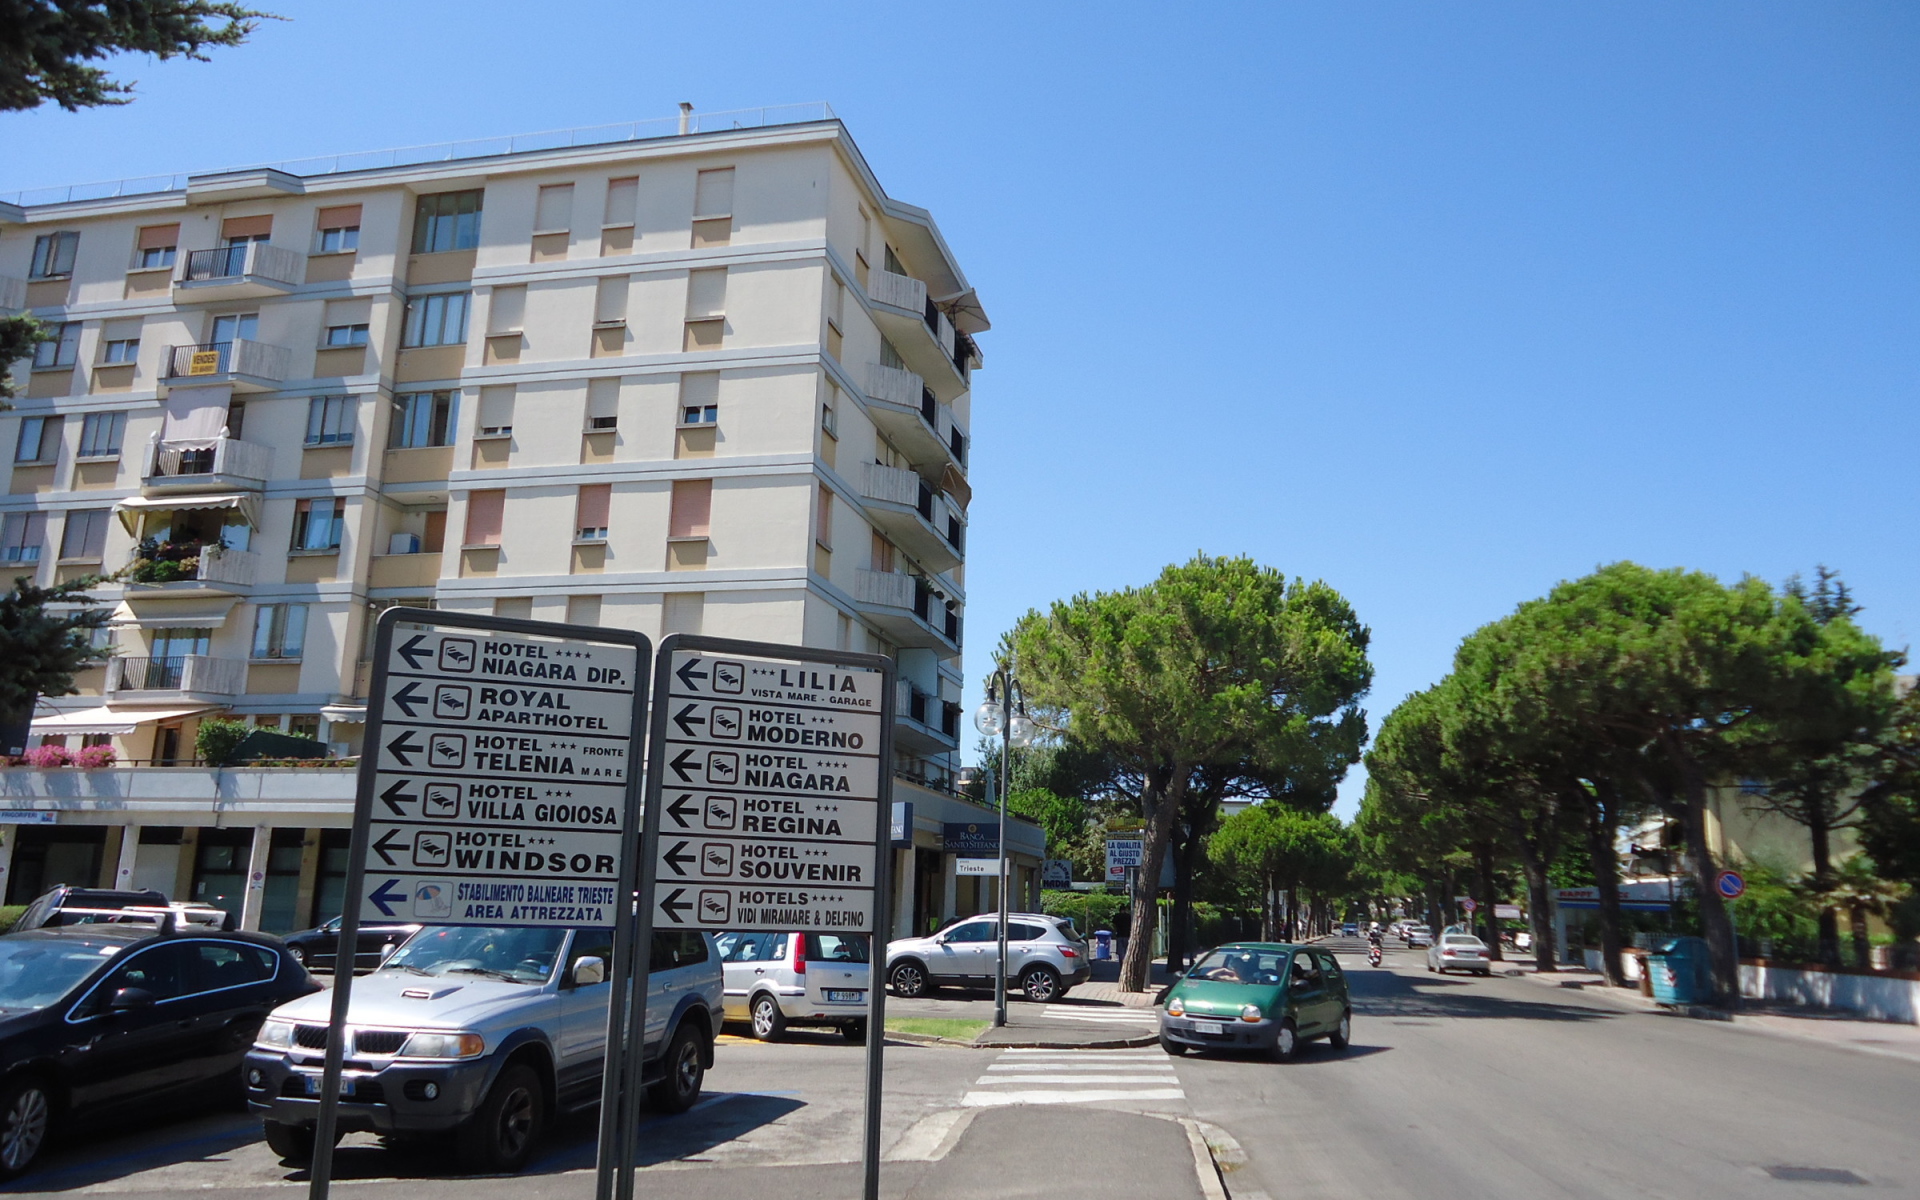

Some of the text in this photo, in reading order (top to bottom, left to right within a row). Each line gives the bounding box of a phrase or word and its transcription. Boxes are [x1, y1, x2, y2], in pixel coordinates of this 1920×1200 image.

[484, 642, 548, 659] HOTEL
[481, 658, 626, 685] NIAGARA DIP.
[780, 669, 856, 693] LILIA
[479, 688, 571, 710] ROYAL
[751, 689, 783, 699] VISTA
[787, 692, 817, 702] MARE
[829, 696, 872, 707] GARAGE
[477, 709, 608, 730] APARTHOTEL
[749, 710, 805, 725] HOTEL
[475, 736, 624, 757] HOTEL FRONTE
[747, 725, 863, 749] MODERNO
[473, 752, 623, 777] TELENIA MARE
[746, 754, 808, 769] HOTEL
[744, 770, 851, 792] NIAGARA
[469, 784, 538, 800] HOTEL
[468, 801, 617, 825] VILLA GIOIOSA
[744, 800, 804, 814] HOTEL
[742, 815, 842, 835] REGINA
[456, 832, 525, 848] HOTEL
[945, 840, 968, 849] SANTO
[960, 831, 985, 841] BANCA
[741, 845, 799, 859] HOTEL
[455, 850, 614, 874] WINDSOR
[739, 860, 861, 882] SOUVENIR
[458, 883, 614, 904] STABILIMENTO BALNEARE TRIESTE
[739, 891, 809, 905] HOTELS
[464, 905, 602, 921] AREA ATTREZZATA
[737, 908, 864, 927] VIDI MIRAMARE & DELFINO
